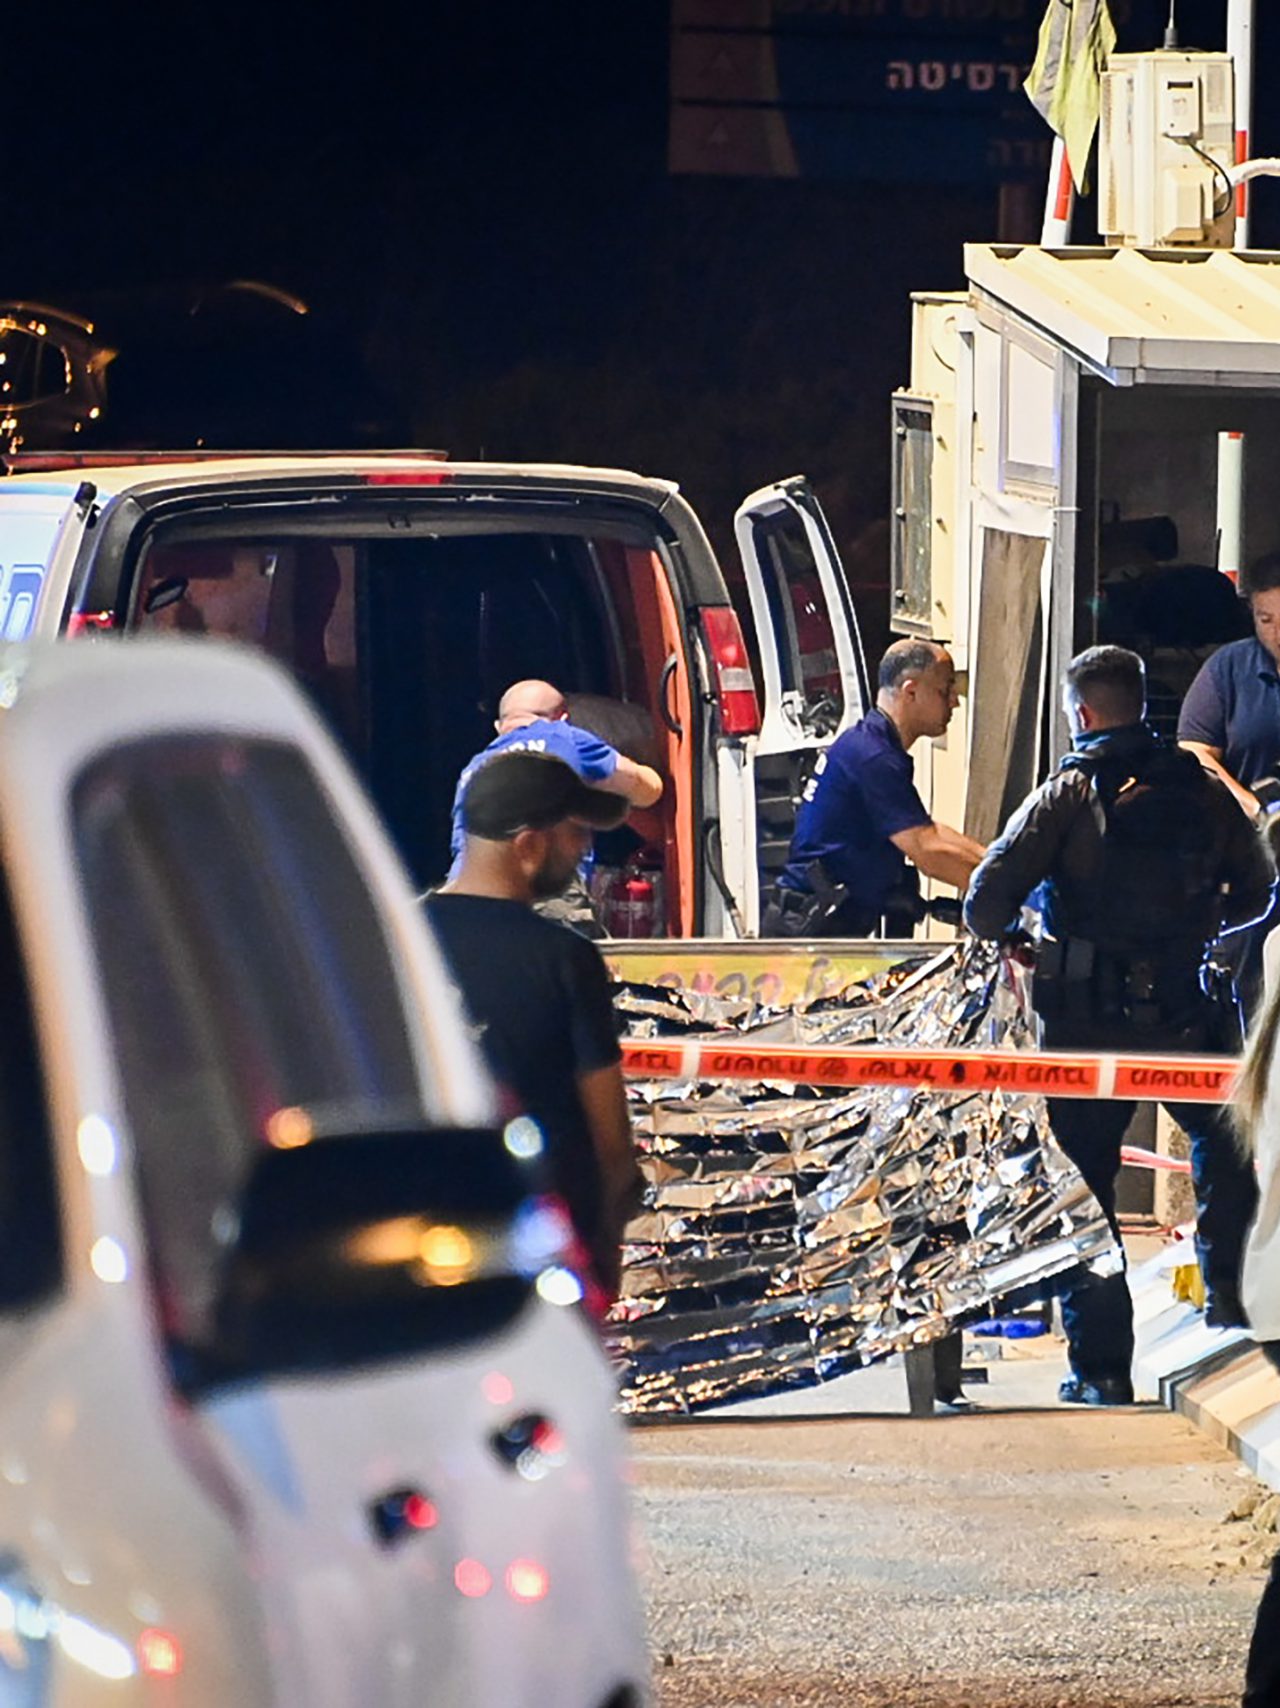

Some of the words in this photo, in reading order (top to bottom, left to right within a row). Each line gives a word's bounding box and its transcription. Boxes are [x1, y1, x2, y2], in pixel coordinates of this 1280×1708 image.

[886, 60, 1031, 92] רסיטה
[627, 1051, 672, 1070] עבר
[713, 1055, 806, 1075] משטרת
[859, 1060, 935, 1082] ישראל
[984, 1063, 1018, 1084] אין
[1026, 1064, 1090, 1085] מעבר
[1131, 1069, 1223, 1090] משטרת
